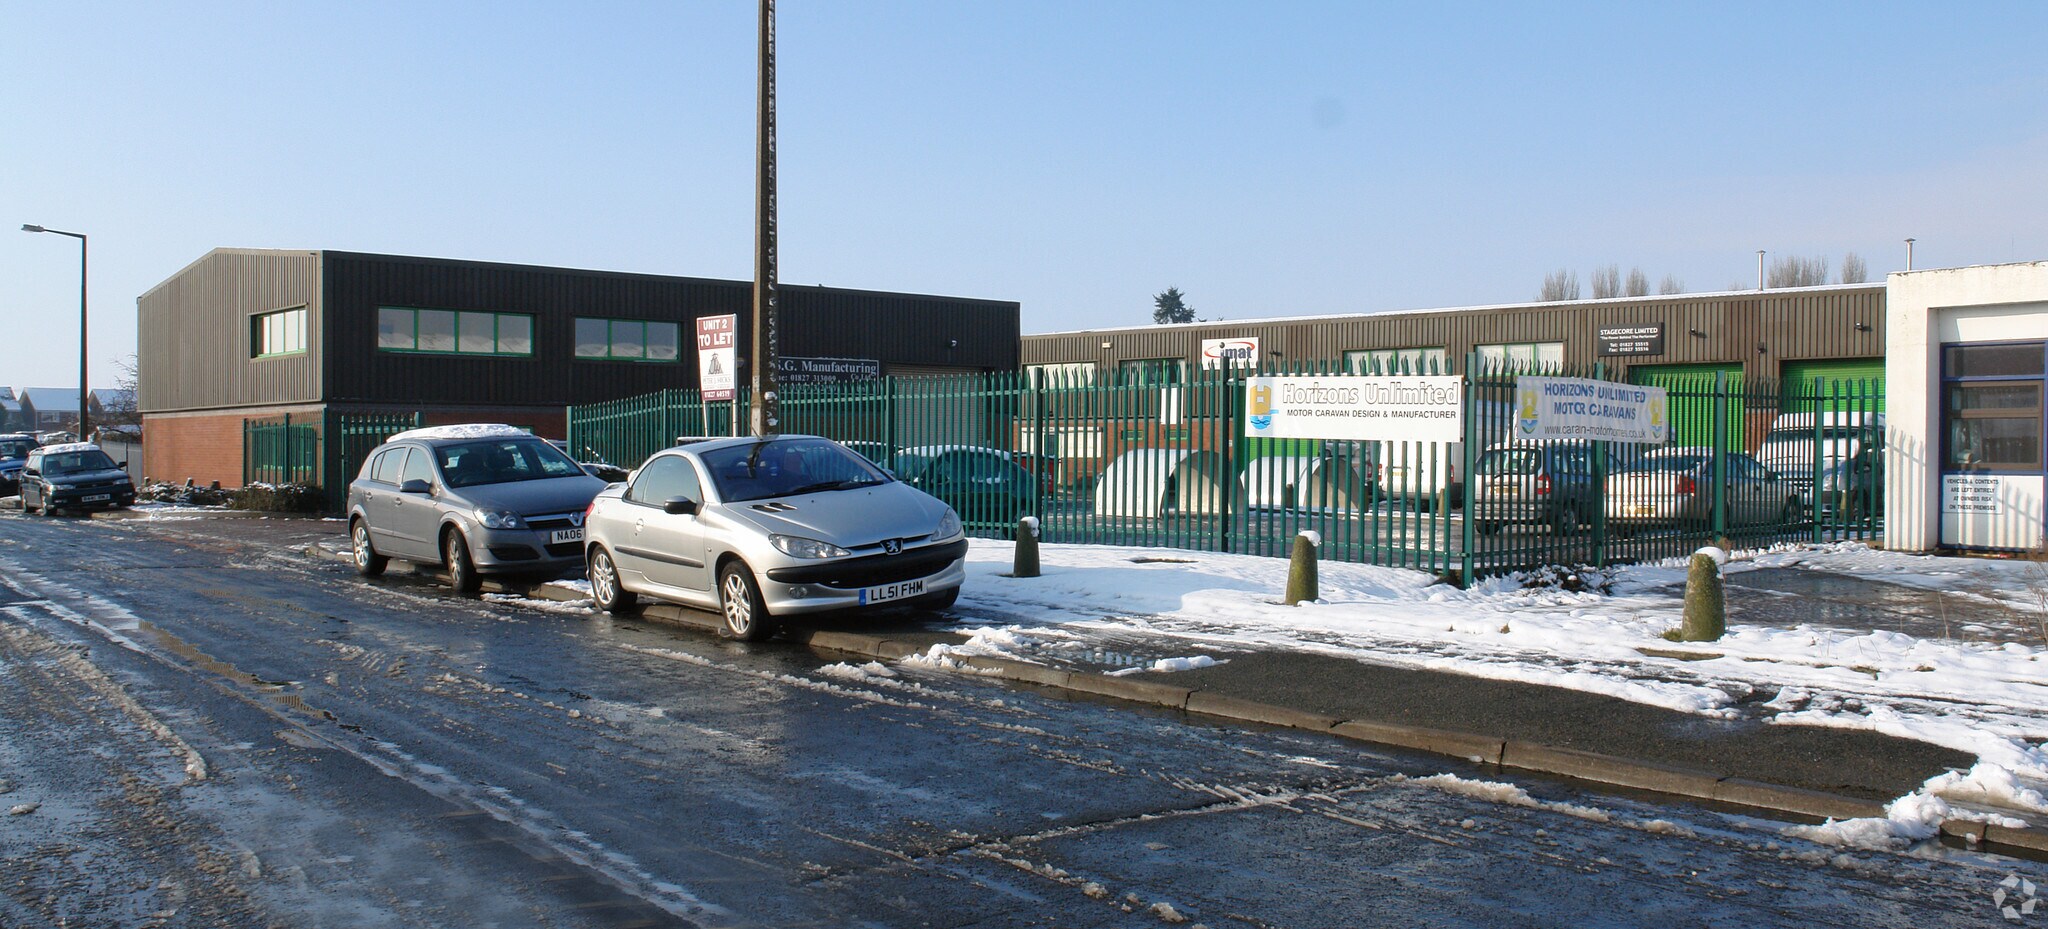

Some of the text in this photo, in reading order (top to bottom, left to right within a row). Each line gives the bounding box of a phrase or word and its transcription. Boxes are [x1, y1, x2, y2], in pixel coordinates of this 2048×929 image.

[703, 319, 728, 331] UNIT 2
[699, 332, 732, 347] TO LET
[1219, 342, 1252, 359] imat
[801, 361, 877, 376] Manufacturing
[790, 374, 810, 382] 01827
[1282, 382, 1459, 405] Horizons Unlimited
[1544, 383, 1646, 403] HORIZONS UNLIMITED
[1287, 409, 1457, 419] MOTOR CARAVAN DESIGN & MANUFACTURER
[1554, 402, 1636, 420] MOTOR CARAVANS
[557, 530, 582, 541] NA06
[871, 580, 923, 601] LL51 FHM
